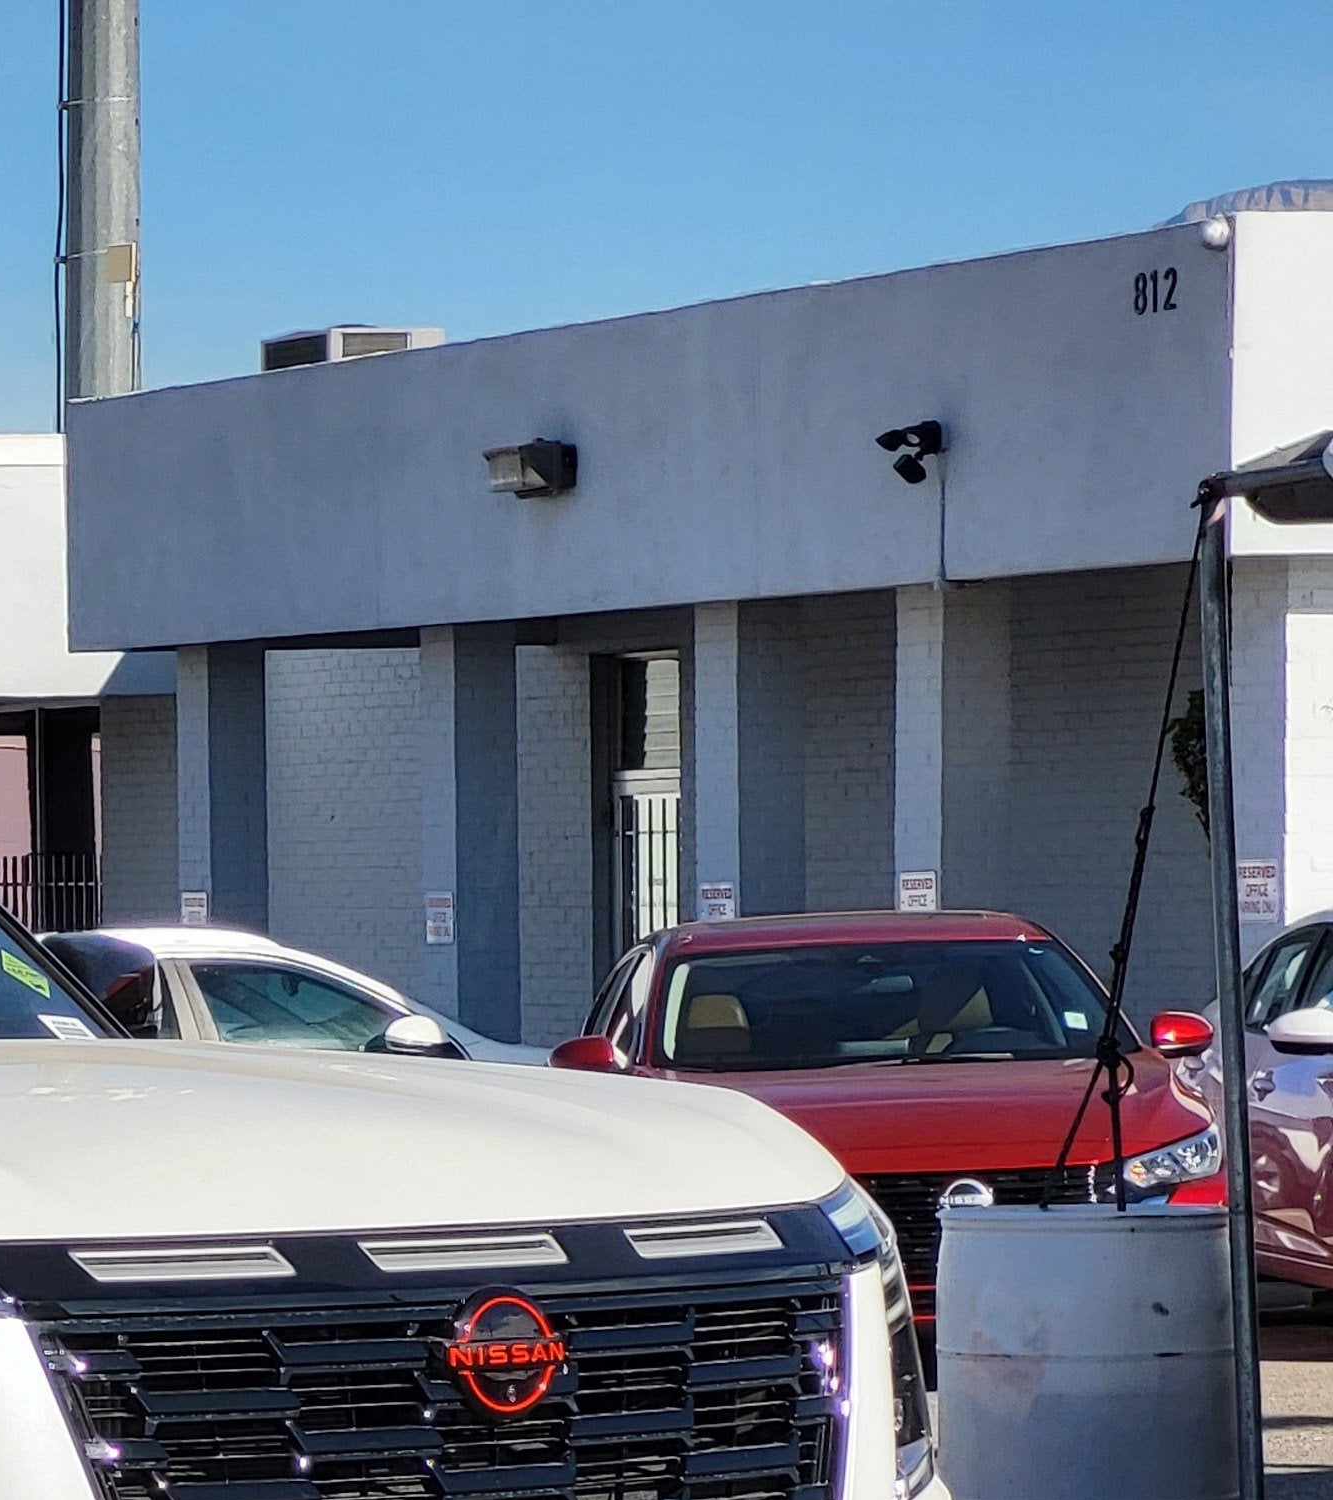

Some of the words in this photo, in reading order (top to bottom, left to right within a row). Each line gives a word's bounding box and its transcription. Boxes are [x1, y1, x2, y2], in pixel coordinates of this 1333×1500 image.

[1133, 267, 1178, 315] 812
[1238, 865, 1276, 879] RESERVED
[448, 1341, 567, 1368] NISSAN
